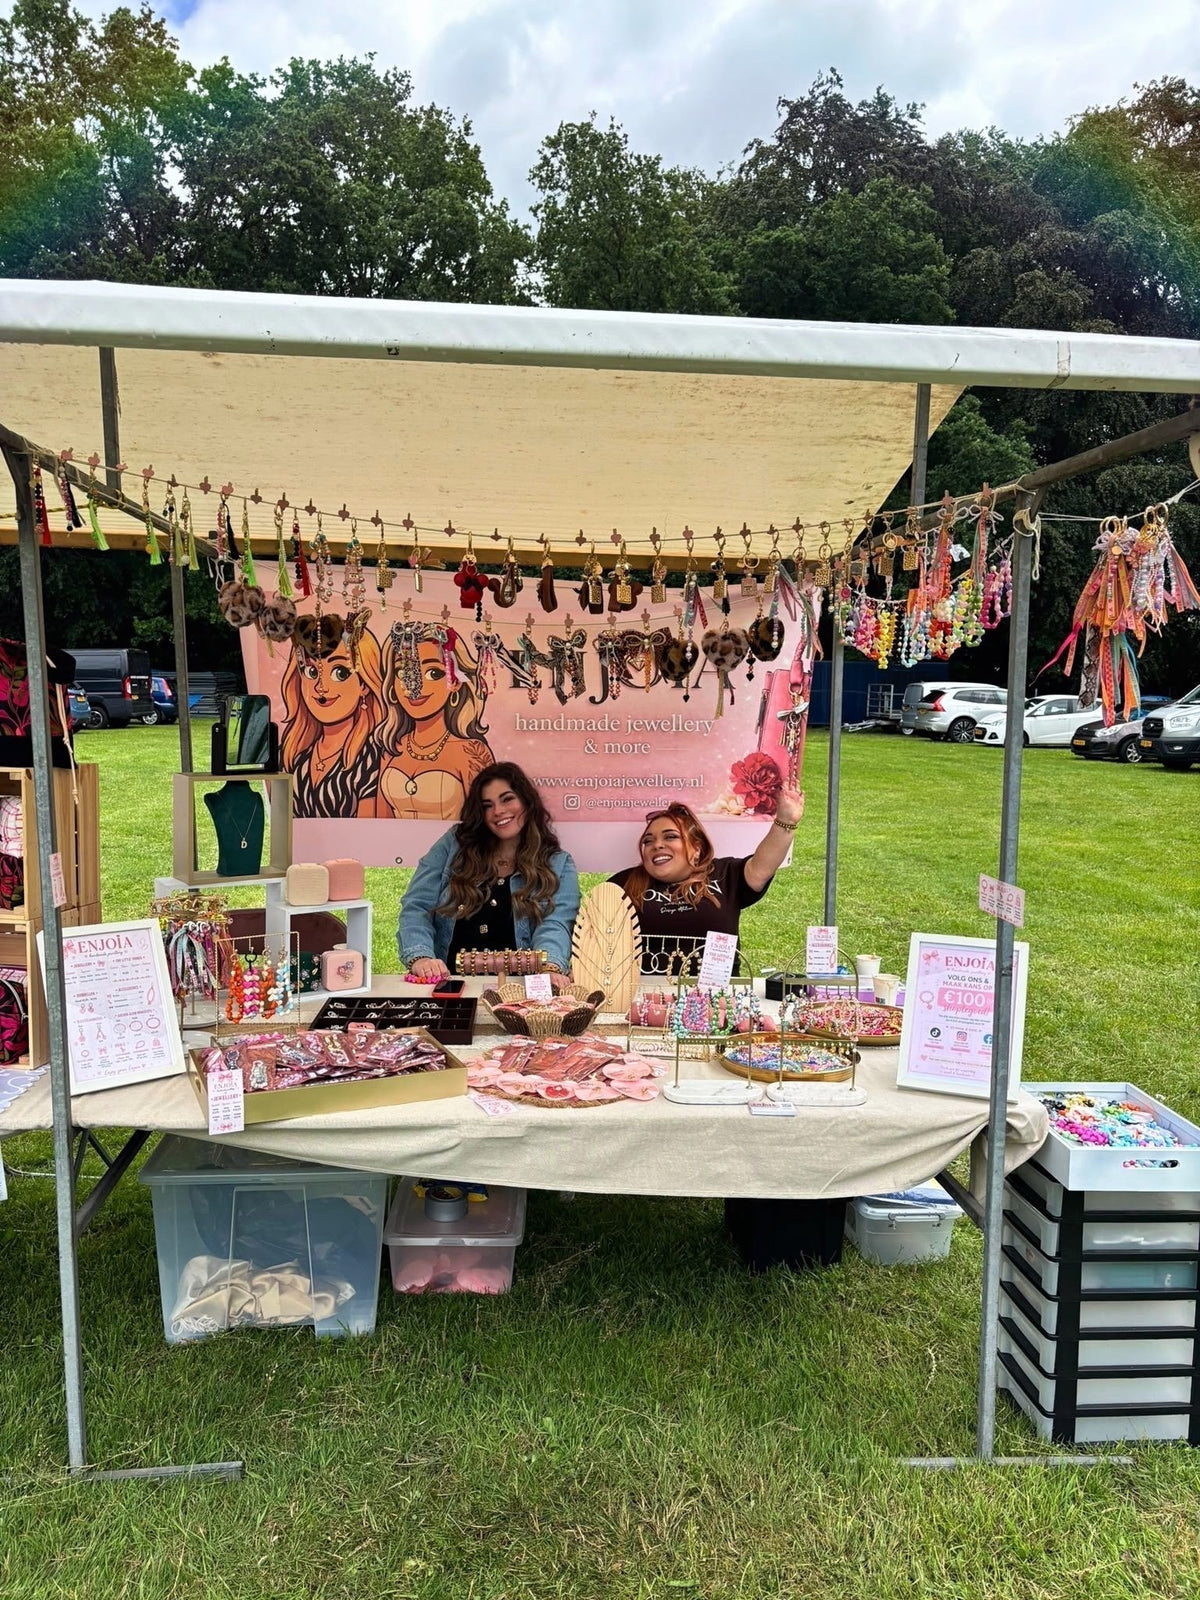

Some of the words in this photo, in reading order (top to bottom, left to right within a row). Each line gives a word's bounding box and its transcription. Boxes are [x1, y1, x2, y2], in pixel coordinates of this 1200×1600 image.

[514, 712, 621, 732] handmade
[625, 714, 714, 736] jewellery
[584, 738, 598, 754] &
[604, 742, 651, 754] more
[533, 774, 705, 790] www.enjoiajewellery.nl
[585, 796, 676, 810] @enjoiajeweller
[942, 980, 964, 988] MAAK
[964, 982, 982, 990] KANS
[967, 976, 982, 984] ONS
[943, 989, 986, 1008] €100
